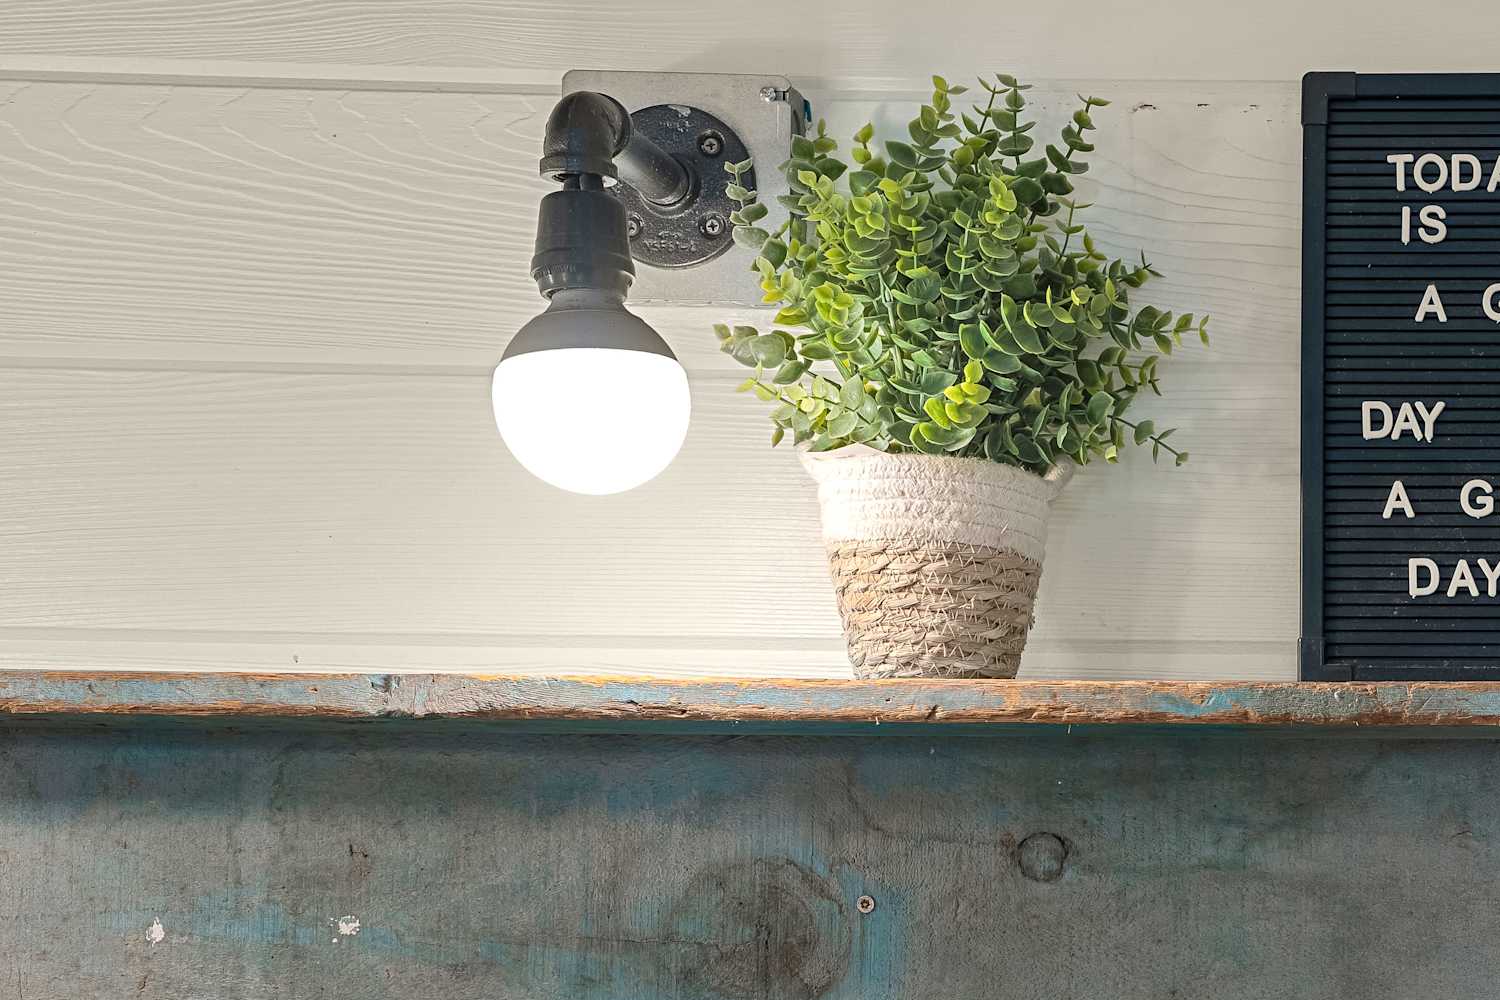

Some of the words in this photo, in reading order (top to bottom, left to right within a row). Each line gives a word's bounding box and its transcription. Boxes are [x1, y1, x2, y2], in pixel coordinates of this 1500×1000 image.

[1402, 205, 1446, 245] IS
[1415, 285, 1447, 322] A
[1362, 401, 1445, 443] DAY
[1383, 481, 1414, 518] A
